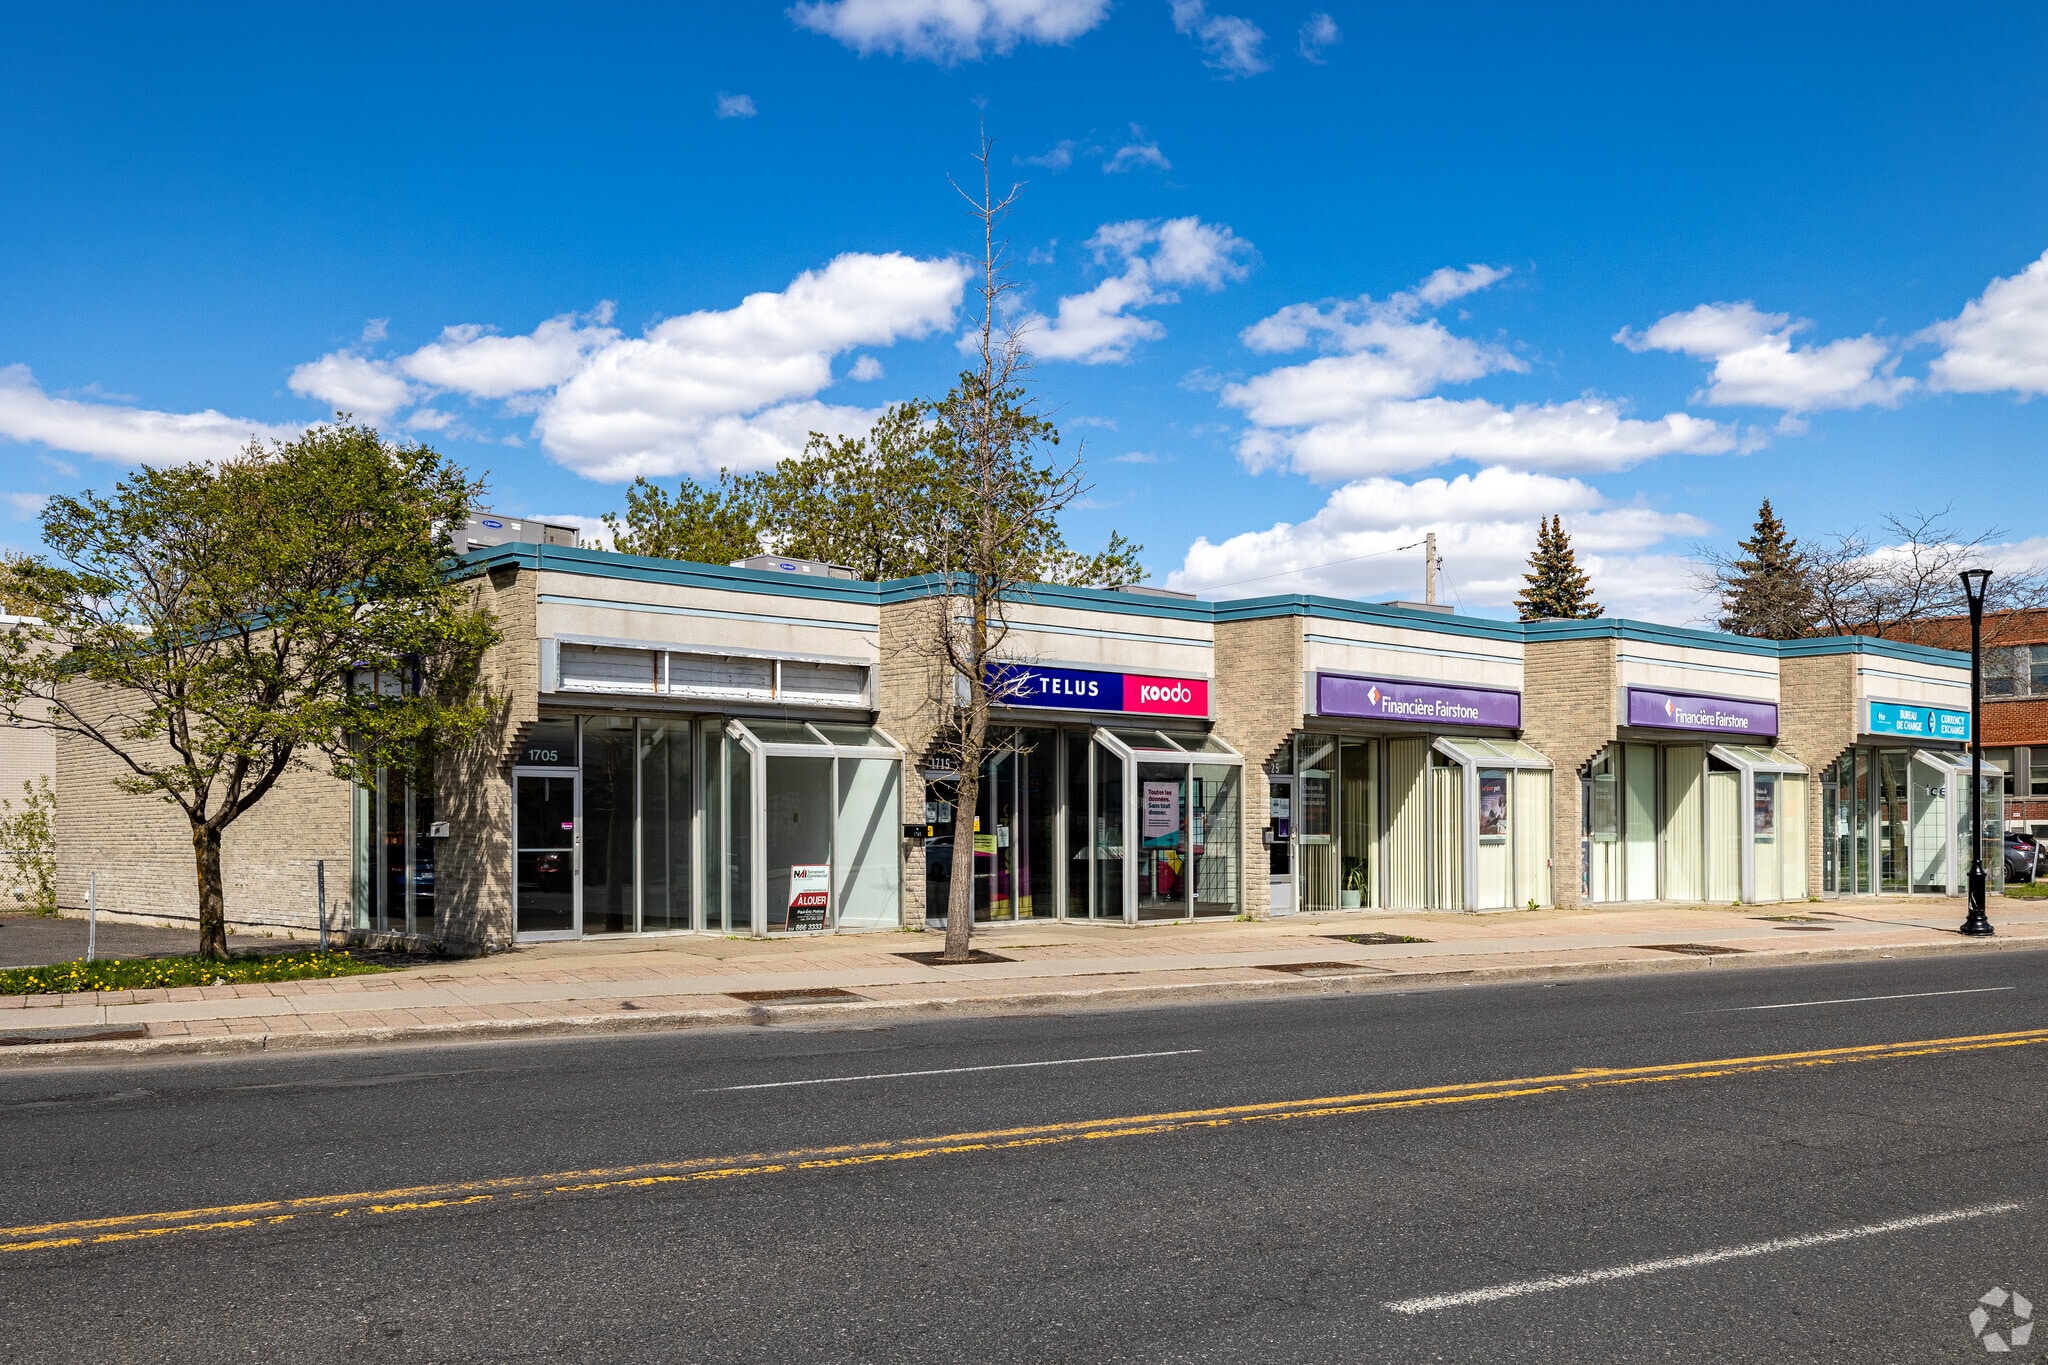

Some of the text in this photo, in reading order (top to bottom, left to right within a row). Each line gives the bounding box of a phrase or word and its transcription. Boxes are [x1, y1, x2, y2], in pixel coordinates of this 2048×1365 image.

[1040, 677, 1099, 697] TELUS
[1382, 696, 1479, 719] Financière Fairstone
[1676, 708, 1749, 728] Financière Fairstone
[1900, 710, 1918, 720] BUREAU
[1941, 715, 1965, 725] CURRENCY
[1896, 720, 1923, 731] DE CHANGE
[1941, 725, 1965, 735] EXCHANGE
[528, 749, 558, 761] 1705
[931, 758, 950, 769] 1715
[1925, 784, 1946, 797] ice
[794, 869, 807, 878] NAI
[798, 895, 826, 905] À LOUER
